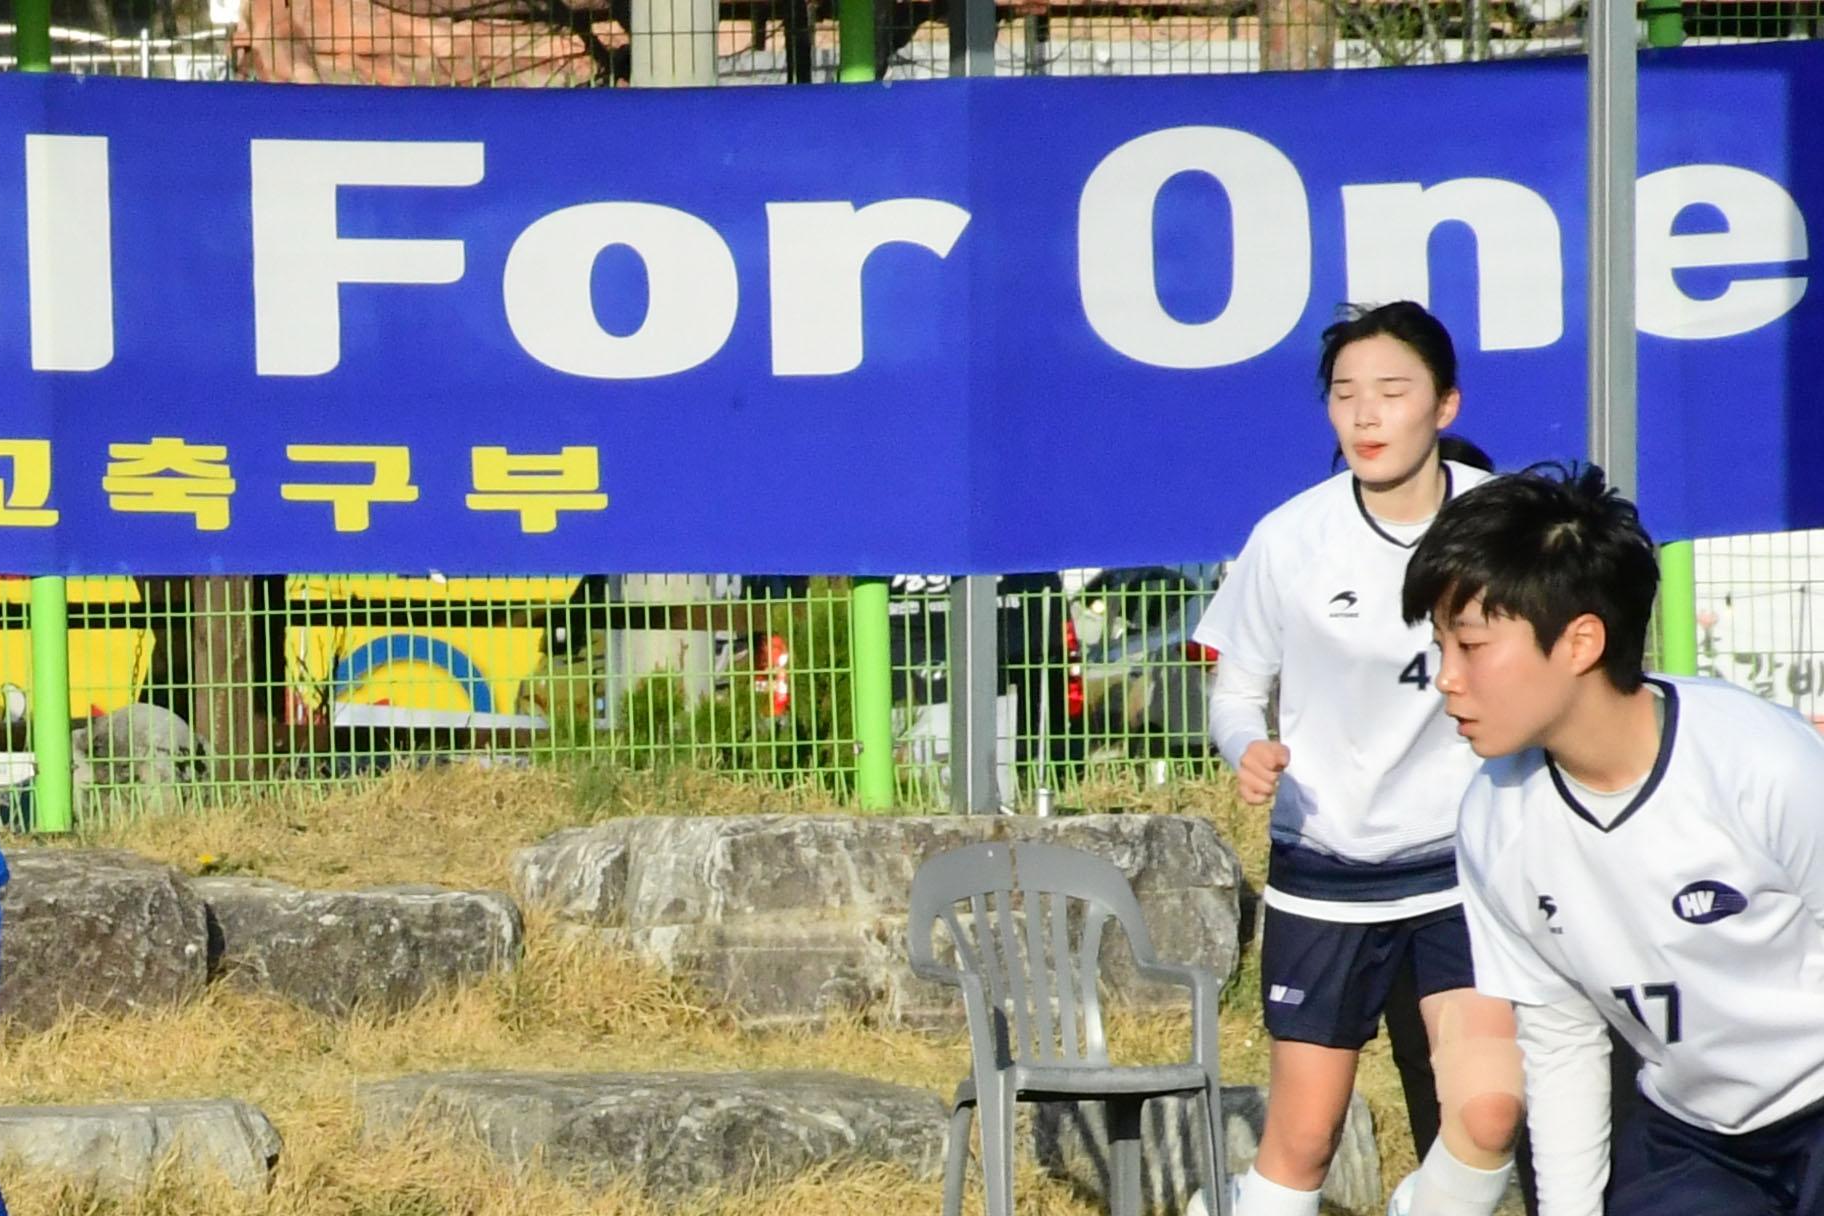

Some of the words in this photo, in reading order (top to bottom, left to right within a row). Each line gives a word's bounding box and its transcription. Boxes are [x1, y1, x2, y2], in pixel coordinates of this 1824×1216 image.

[251, 138, 972, 380] For
[1078, 125, 1809, 369] One
[1398, 651, 1431, 691] 4
[1611, 980, 1682, 1045] 17
